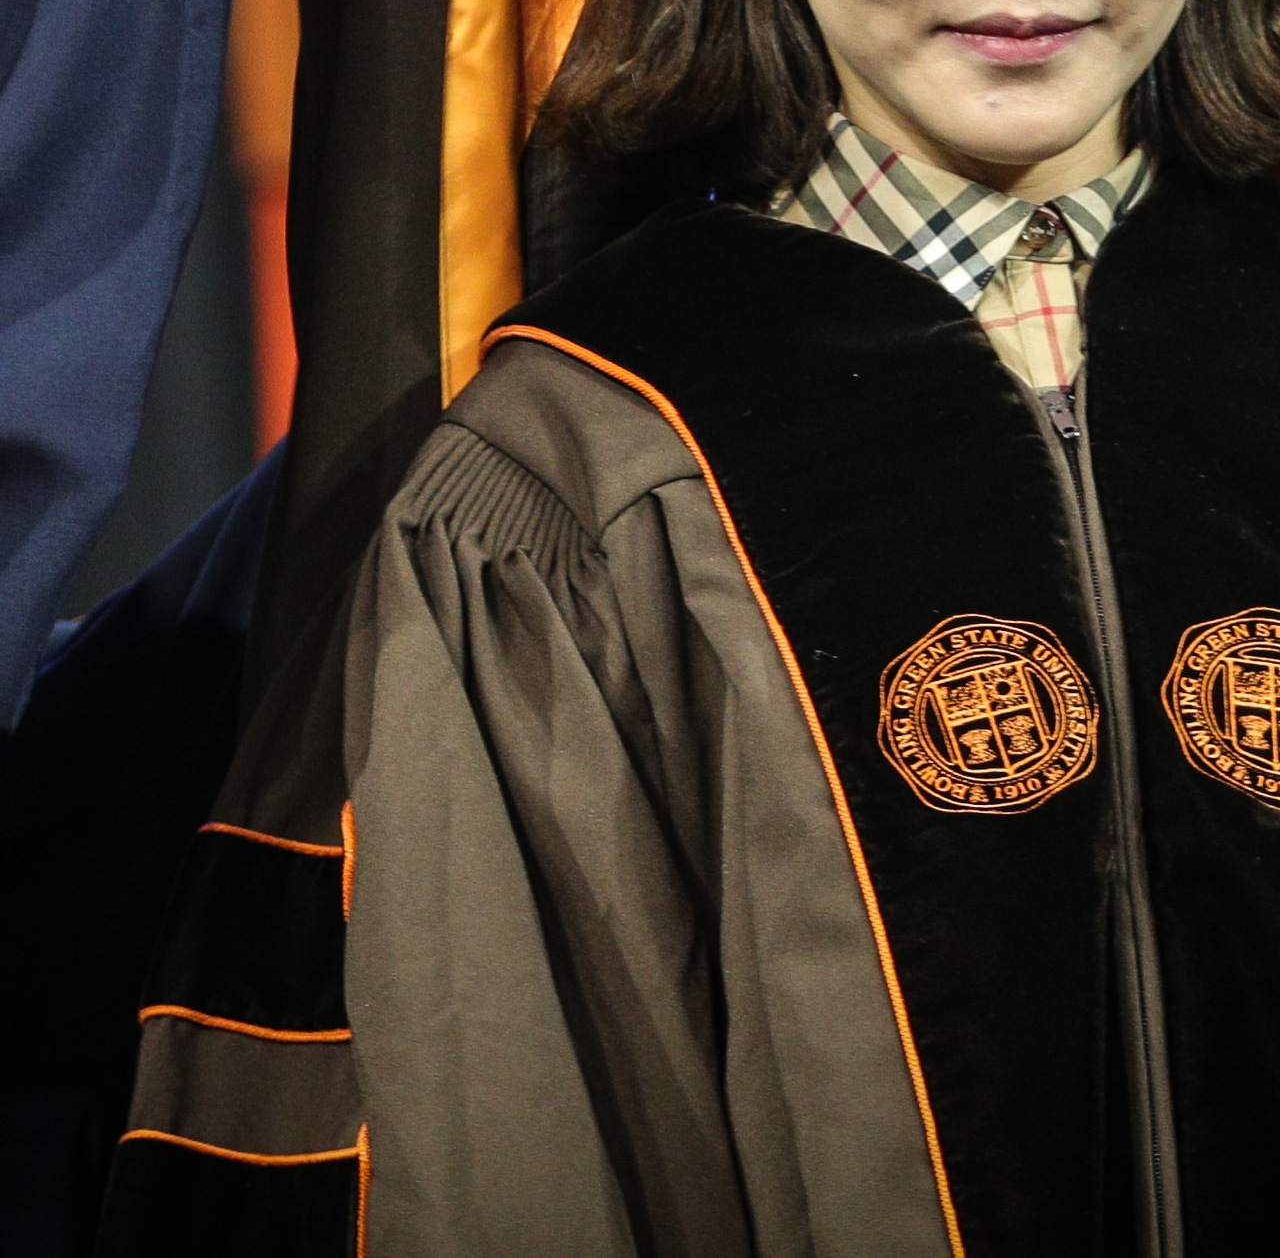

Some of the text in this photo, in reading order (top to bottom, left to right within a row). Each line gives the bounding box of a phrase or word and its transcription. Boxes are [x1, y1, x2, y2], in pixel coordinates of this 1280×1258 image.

[1187, 623, 1251, 672] GREEN
[892, 629, 1086, 802] BOWLING GREEN STATE UNIVERSITY
[1179, 676, 1232, 773] BOWLING
[993, 776, 1042, 800] 1910
